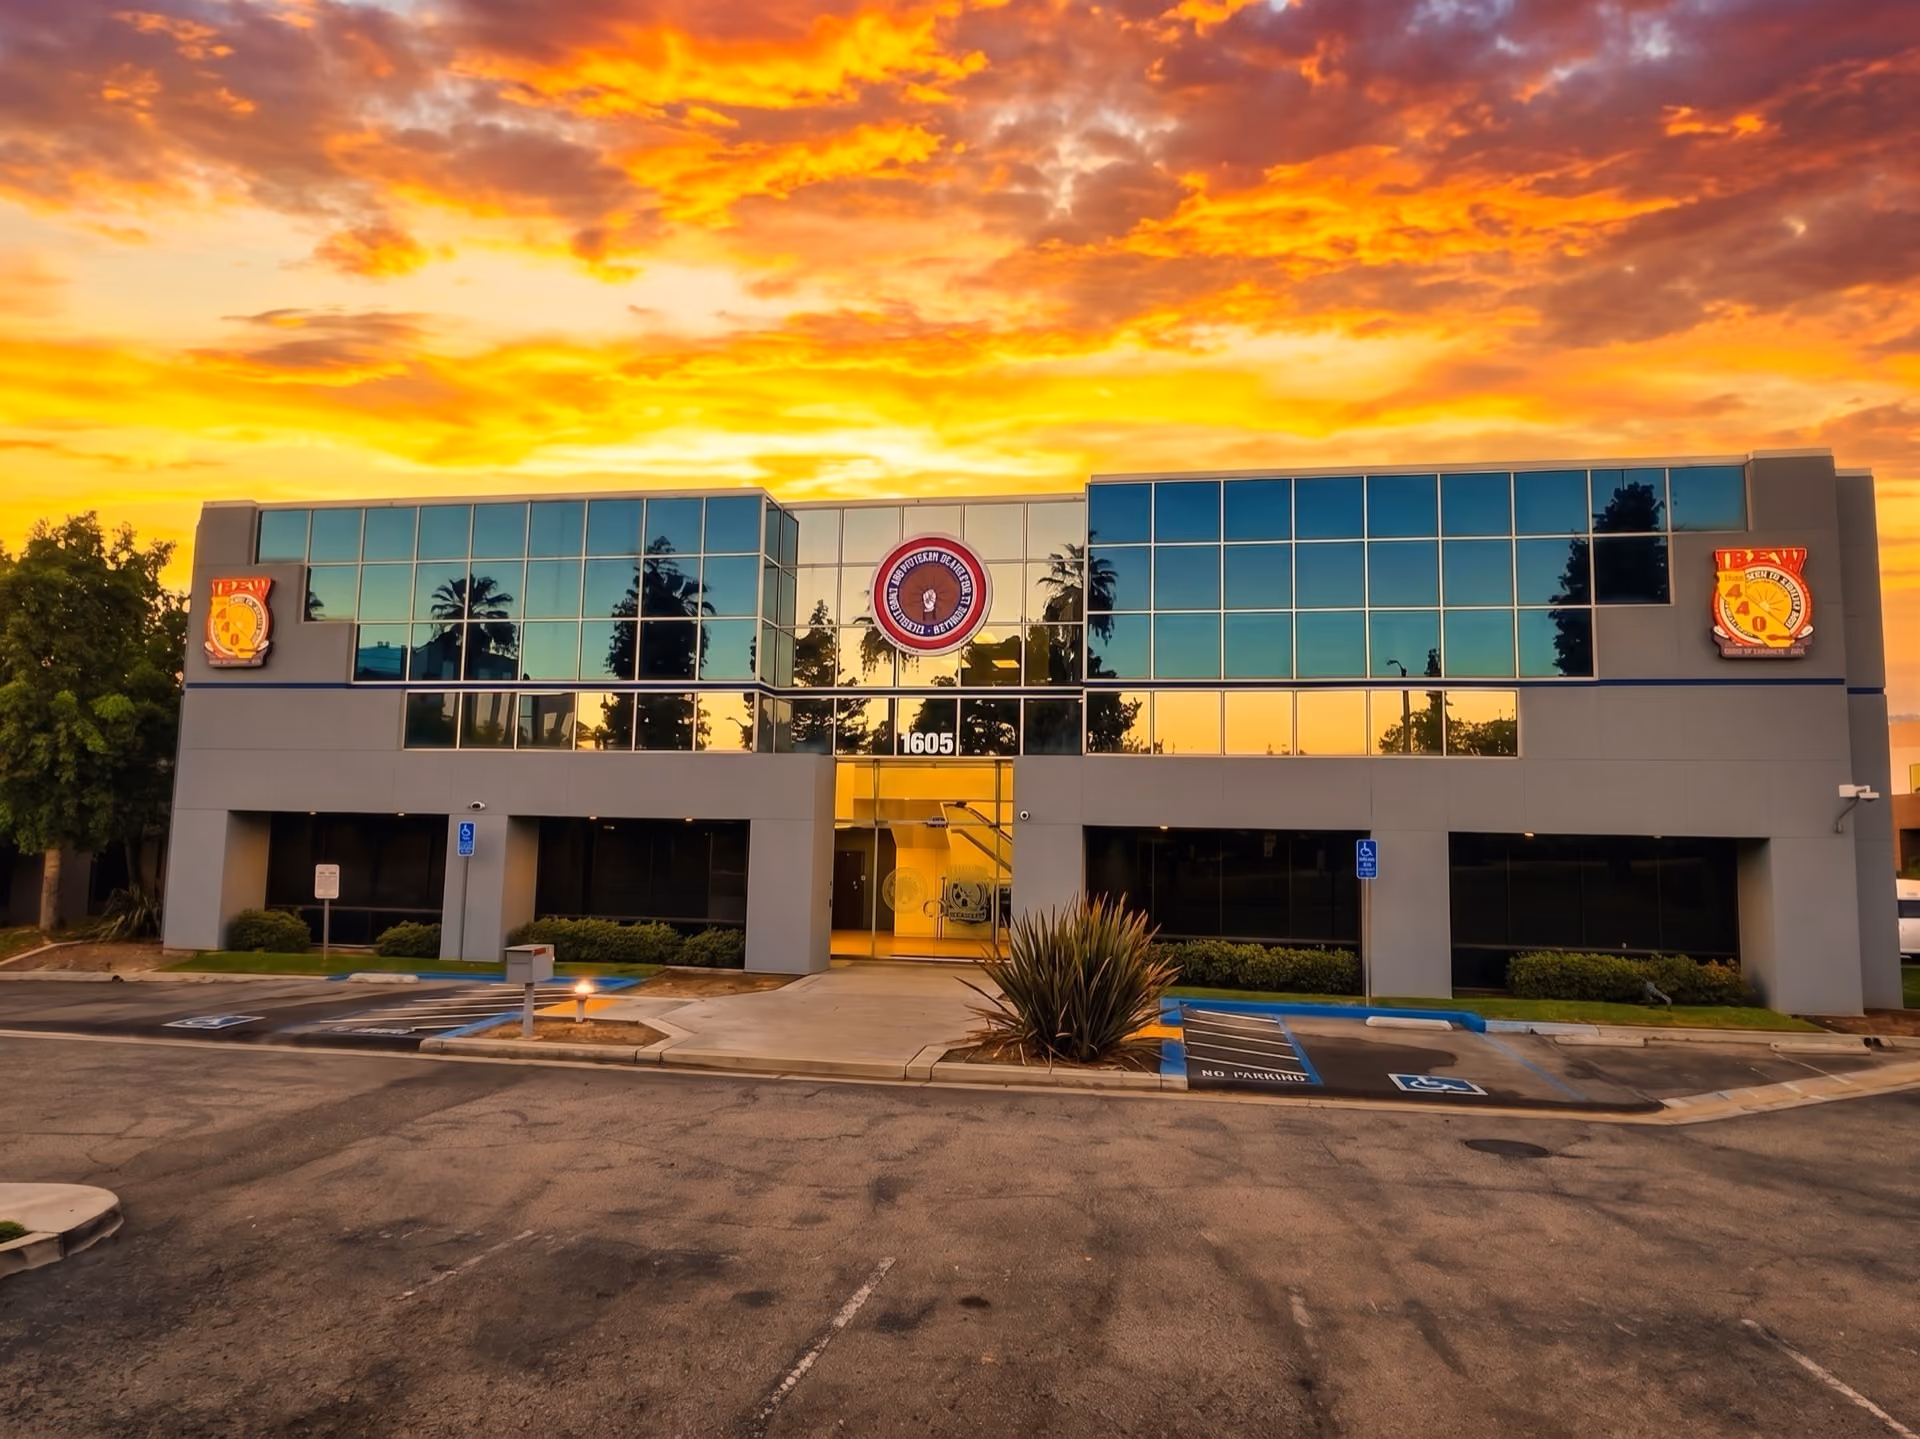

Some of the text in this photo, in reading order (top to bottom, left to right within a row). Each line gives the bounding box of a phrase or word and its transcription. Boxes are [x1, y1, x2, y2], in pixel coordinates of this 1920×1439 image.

[1717, 549, 1806, 573] IBEW
[900, 732, 954, 754] 1605
[1201, 1069, 1306, 1082] NO PARKING
